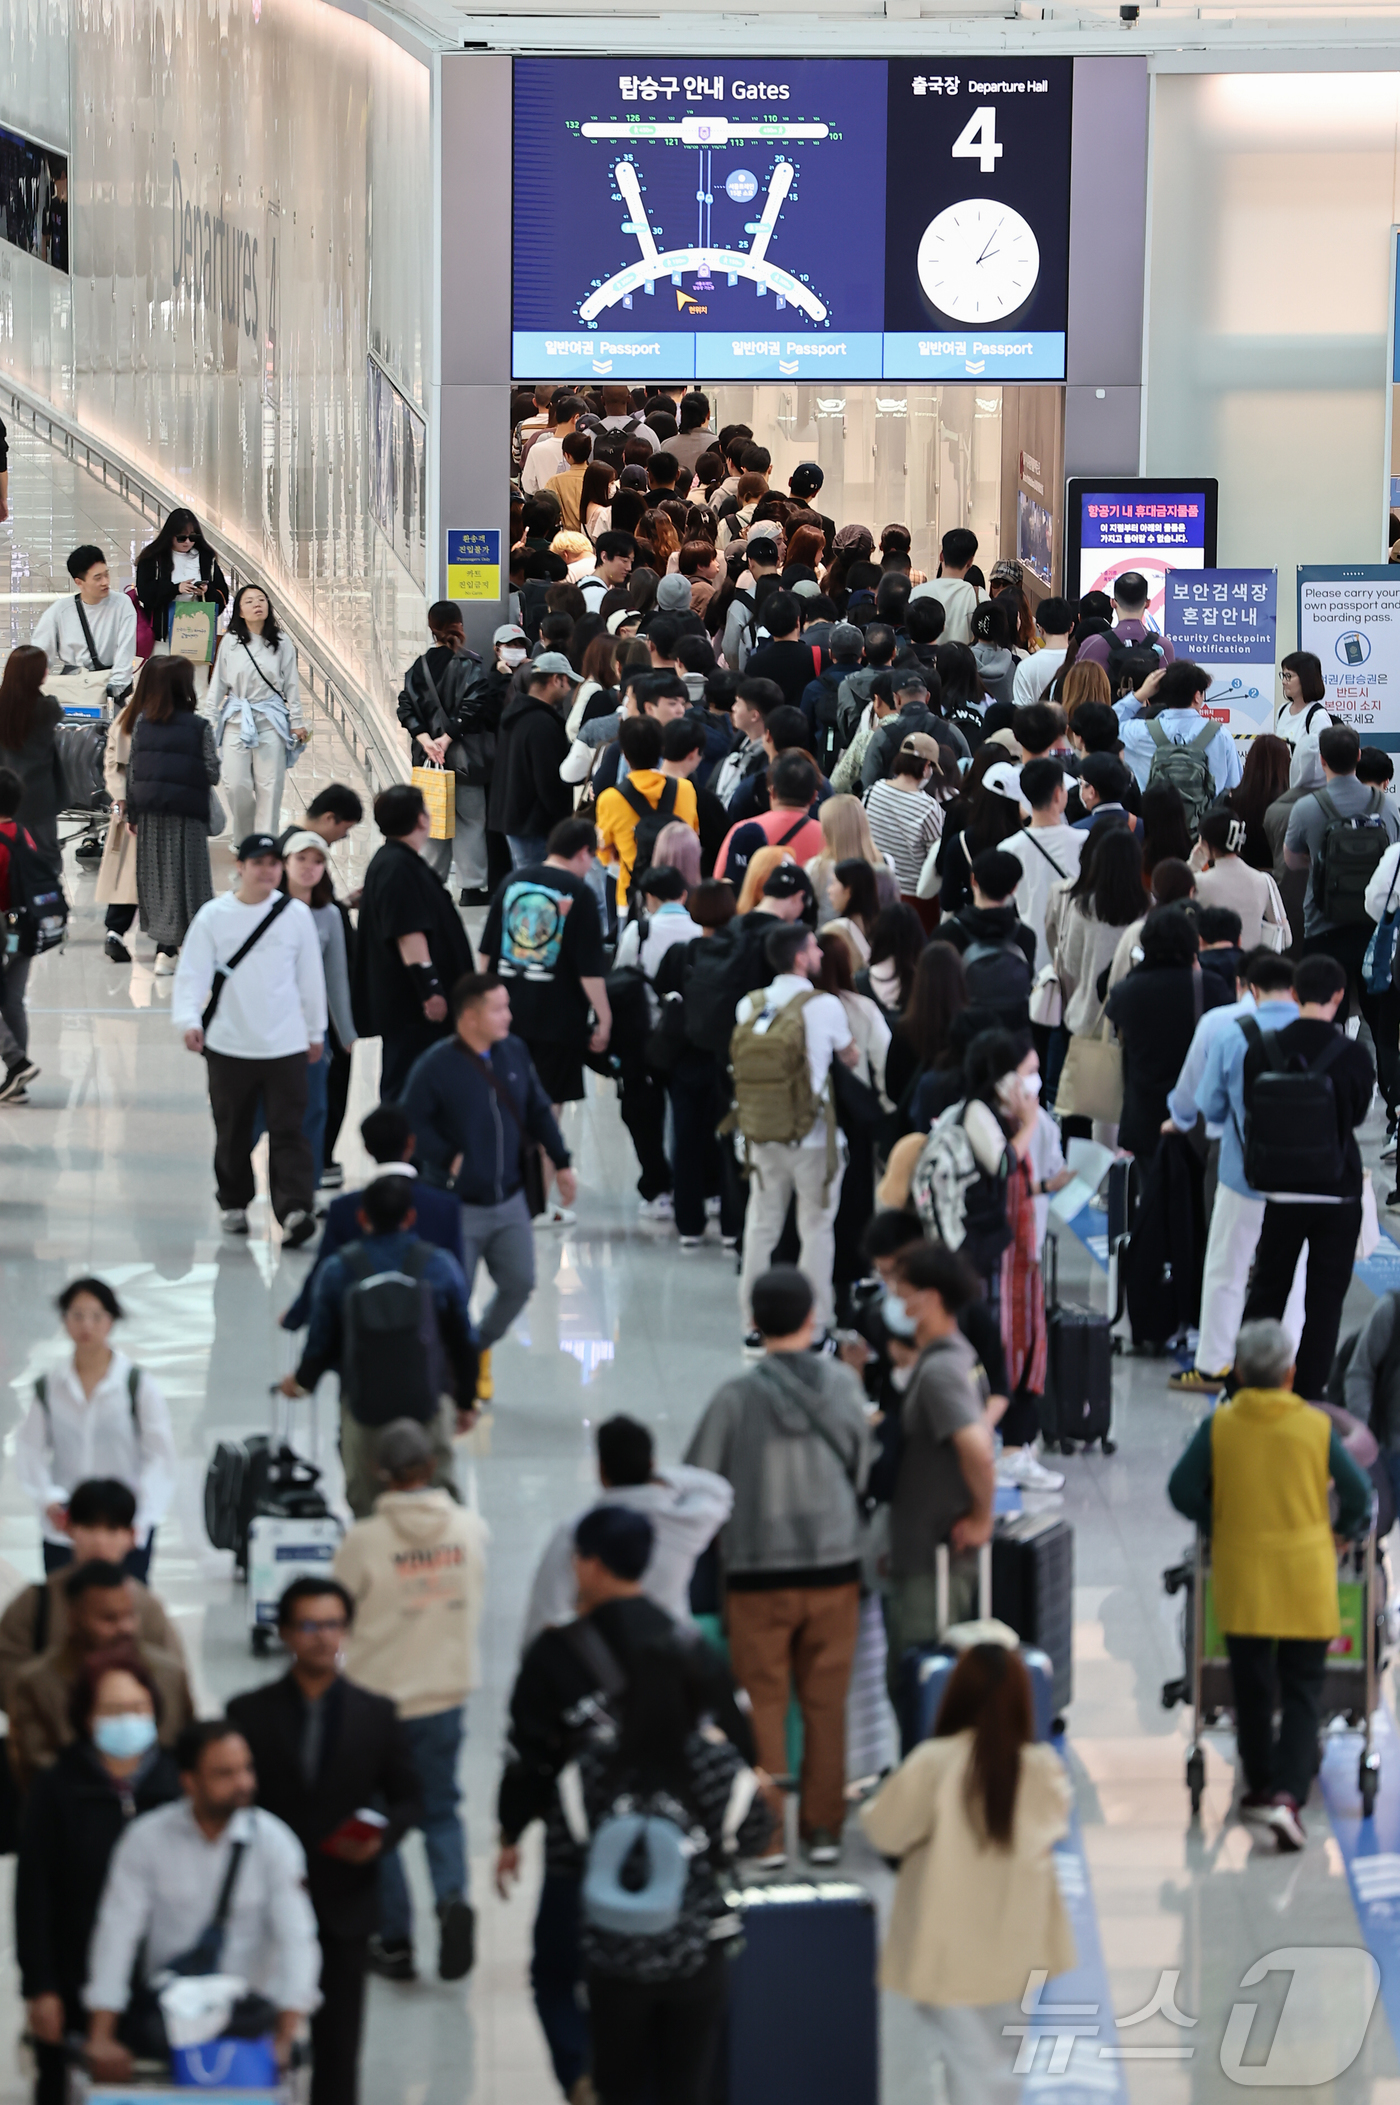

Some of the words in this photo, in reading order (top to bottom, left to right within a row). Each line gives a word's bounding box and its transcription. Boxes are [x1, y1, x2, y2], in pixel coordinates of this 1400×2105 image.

[619, 76, 680, 101] 탑승구
[683, 76, 725, 101] 안내
[731, 80, 790, 101] Gates
[911, 75, 961, 96] 출국장
[968, 80, 1025, 95] Departure
[1026, 80, 1049, 94] Hall
[625, 114, 641, 122] 126
[763, 114, 778, 122] 110
[565, 121, 580, 129] 132
[829, 132, 843, 141] 101
[951, 106, 1004, 173] 4
[664, 138, 679, 146] 121
[730, 139, 744, 147] 113
[173, 157, 258, 341] Departures
[590, 279, 601, 287] 45
[674, 274, 680, 282] 4
[730, 274, 735, 282] 3
[759, 284, 764, 292] 2
[587, 321, 598, 329] 50
[824, 319, 830, 327] 5
[545, 340, 594, 356] 일반여권
[600, 341, 661, 357] Passport
[731, 340, 781, 356] 일반여권
[786, 341, 847, 358] Passport
[918, 340, 967, 356] 일반여권
[973, 341, 1034, 357] Passport
[1087, 504, 1120, 518] 항공기
[1122, 504, 1133, 518] 내
[1134, 504, 1199, 518] 휴대금지물품
[1100, 523, 1108, 533] 이
[1100, 534, 1123, 544] 가지고
[1147, 534, 1155, 544] 수
[459, 545, 490, 554] 진입불가
[467, 570, 482, 578] 카트
[459, 581, 489, 589] 진입금지
[1172, 583, 1269, 602] 보안검색장
[1305, 588, 1341, 598] Please
[1344, 589, 1373, 600] carry
[1376, 590, 1400, 600] your
[1304, 602, 1327, 610] own
[1329, 600, 1378, 612] passport
[1182, 607, 1257, 626] 혼잡안내
[1313, 613, 1361, 624] boarding
[1364, 614, 1392, 624] pass.
[1166, 634, 1209, 644] Security
[1212, 634, 1271, 644] Checkpoint
[1188, 644, 1251, 654] Notification
[1336, 687, 1369, 698] 반드시
[1325, 701, 1356, 711] 본인이
[1360, 700, 1381, 711] 소지
